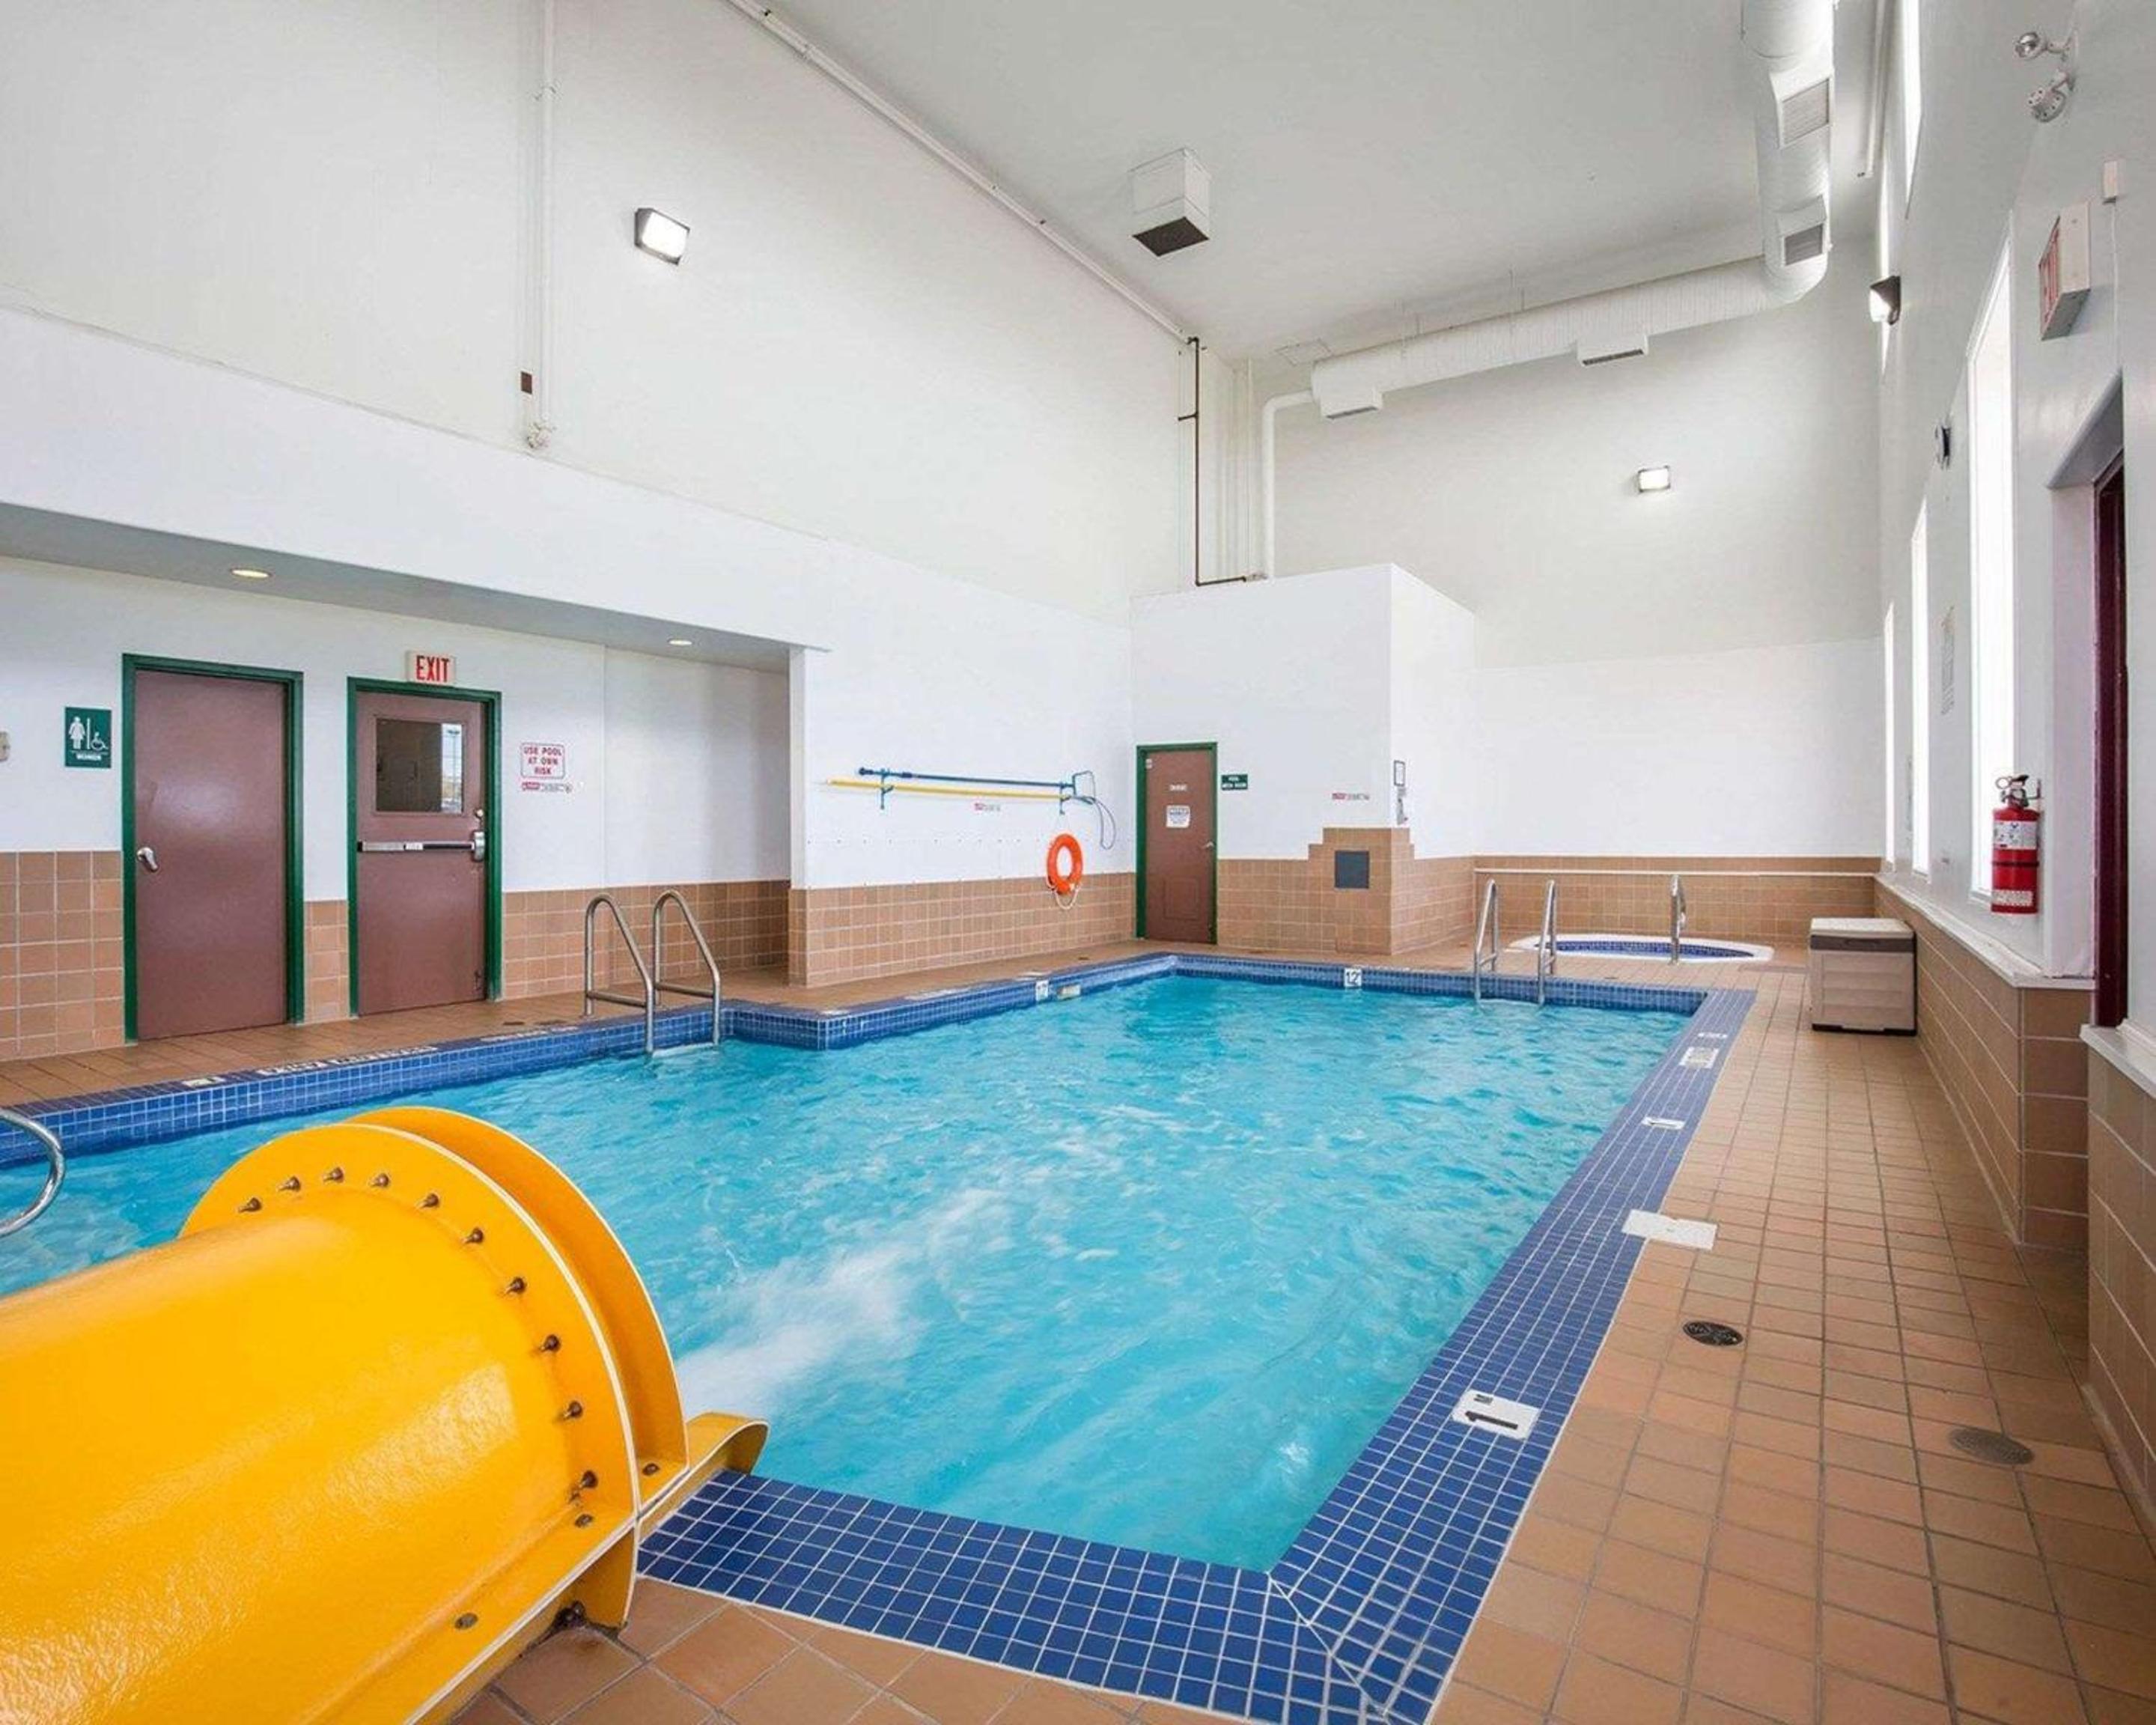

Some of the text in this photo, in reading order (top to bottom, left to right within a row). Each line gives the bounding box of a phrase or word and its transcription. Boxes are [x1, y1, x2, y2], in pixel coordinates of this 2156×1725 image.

[416, 655, 450, 682] EXIT
[523, 746, 561, 756] USE POOL
[528, 756, 538, 764] AT
[535, 767, 552, 775] RISK
